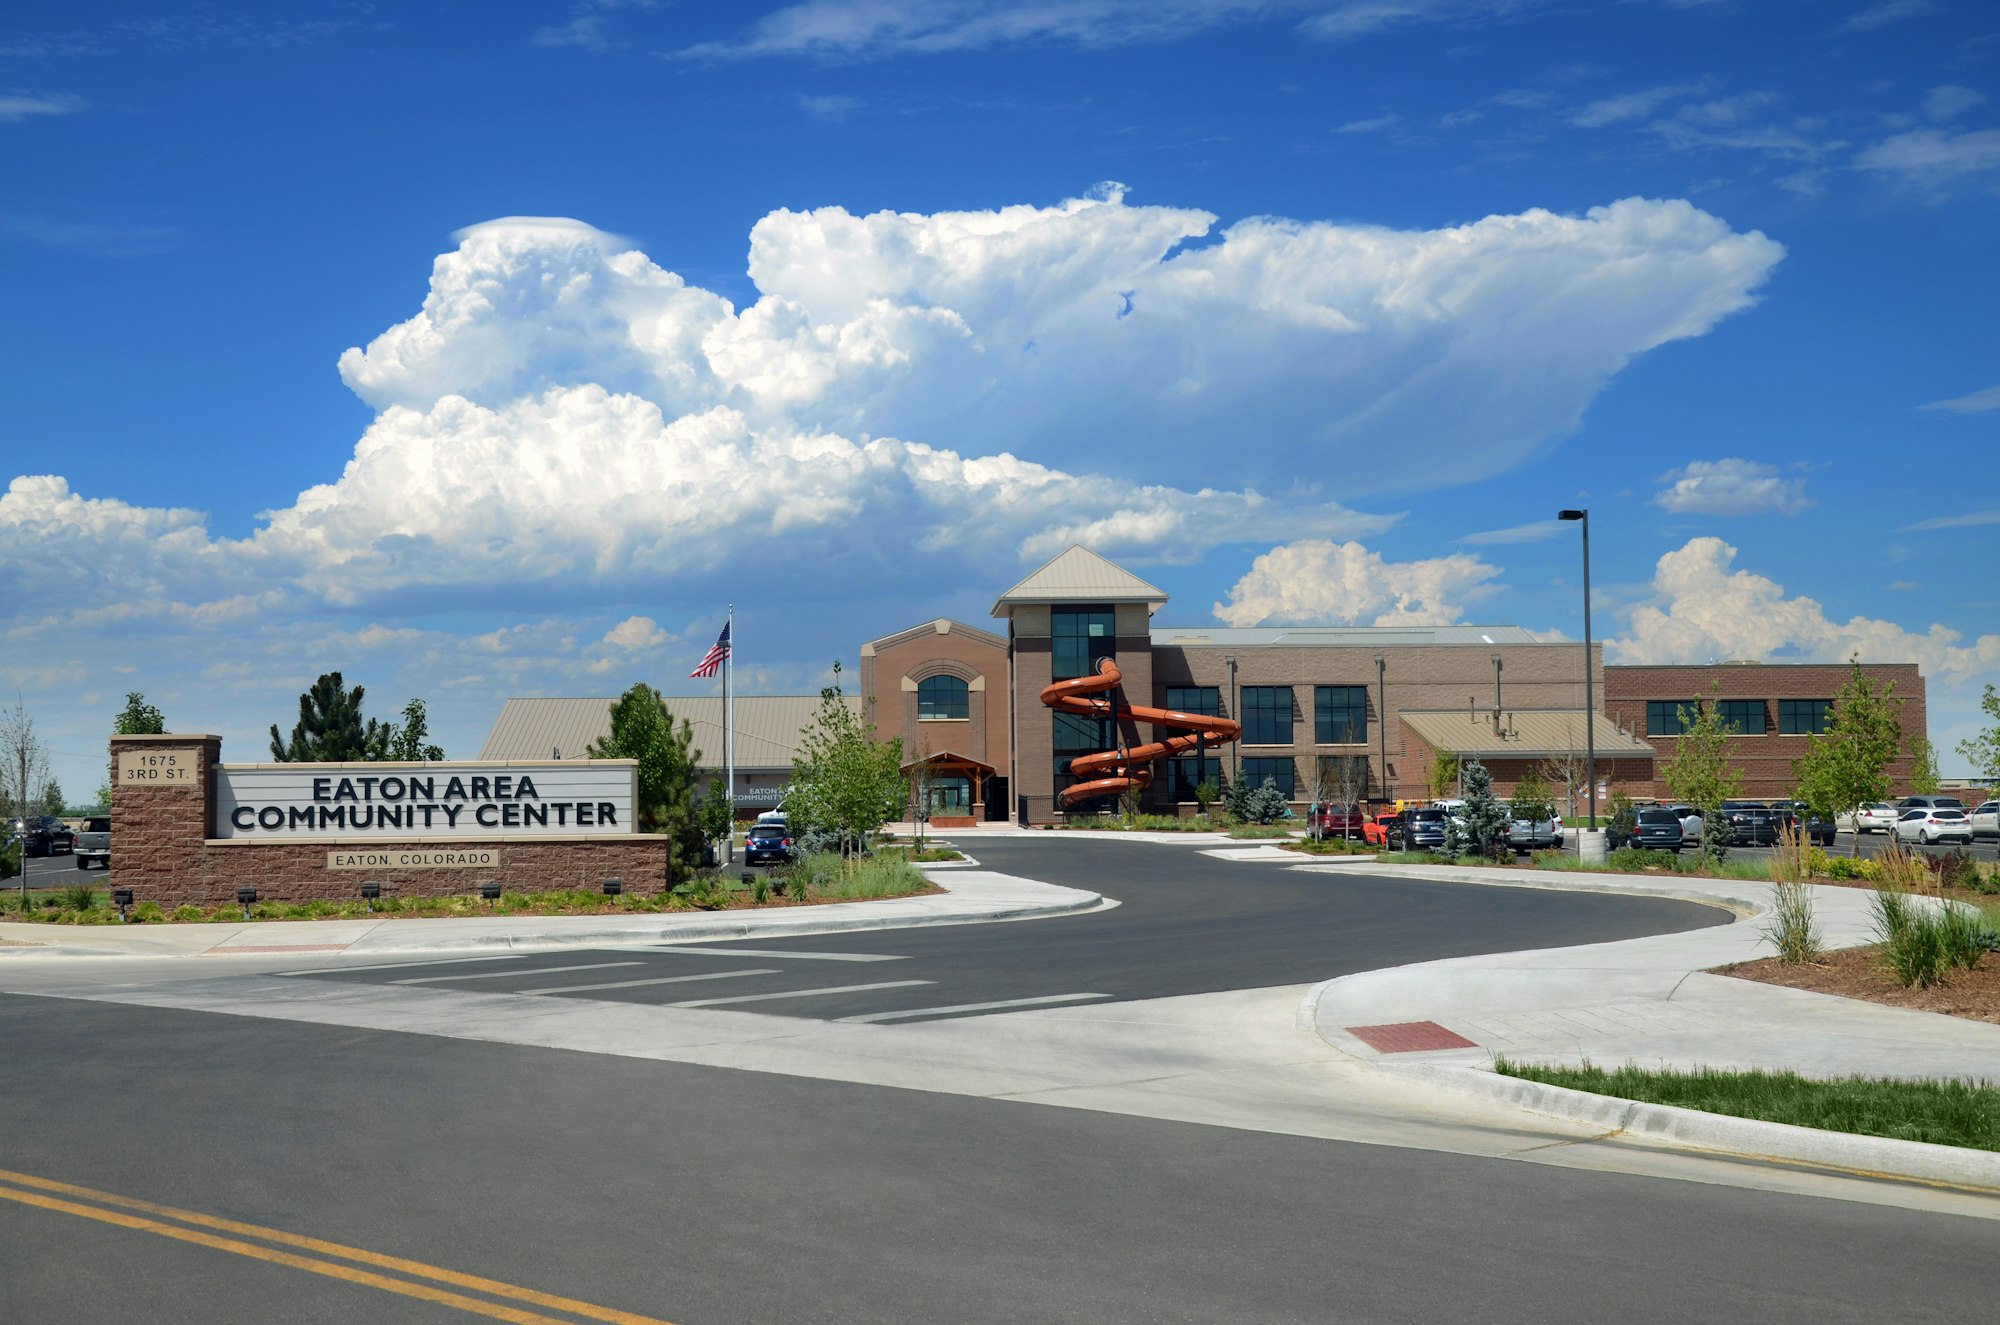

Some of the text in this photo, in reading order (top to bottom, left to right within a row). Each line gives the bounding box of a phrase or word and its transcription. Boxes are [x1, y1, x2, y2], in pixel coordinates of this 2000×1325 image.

[140, 755, 176, 767] 1675
[127, 768, 189, 779] 3RD ST.
[313, 775, 539, 801] EATON AREA
[749, 787, 777, 795] EATON
[231, 802, 617, 829] COMMUNITY CENTER
[335, 853, 491, 866] EATON, COLORADO
